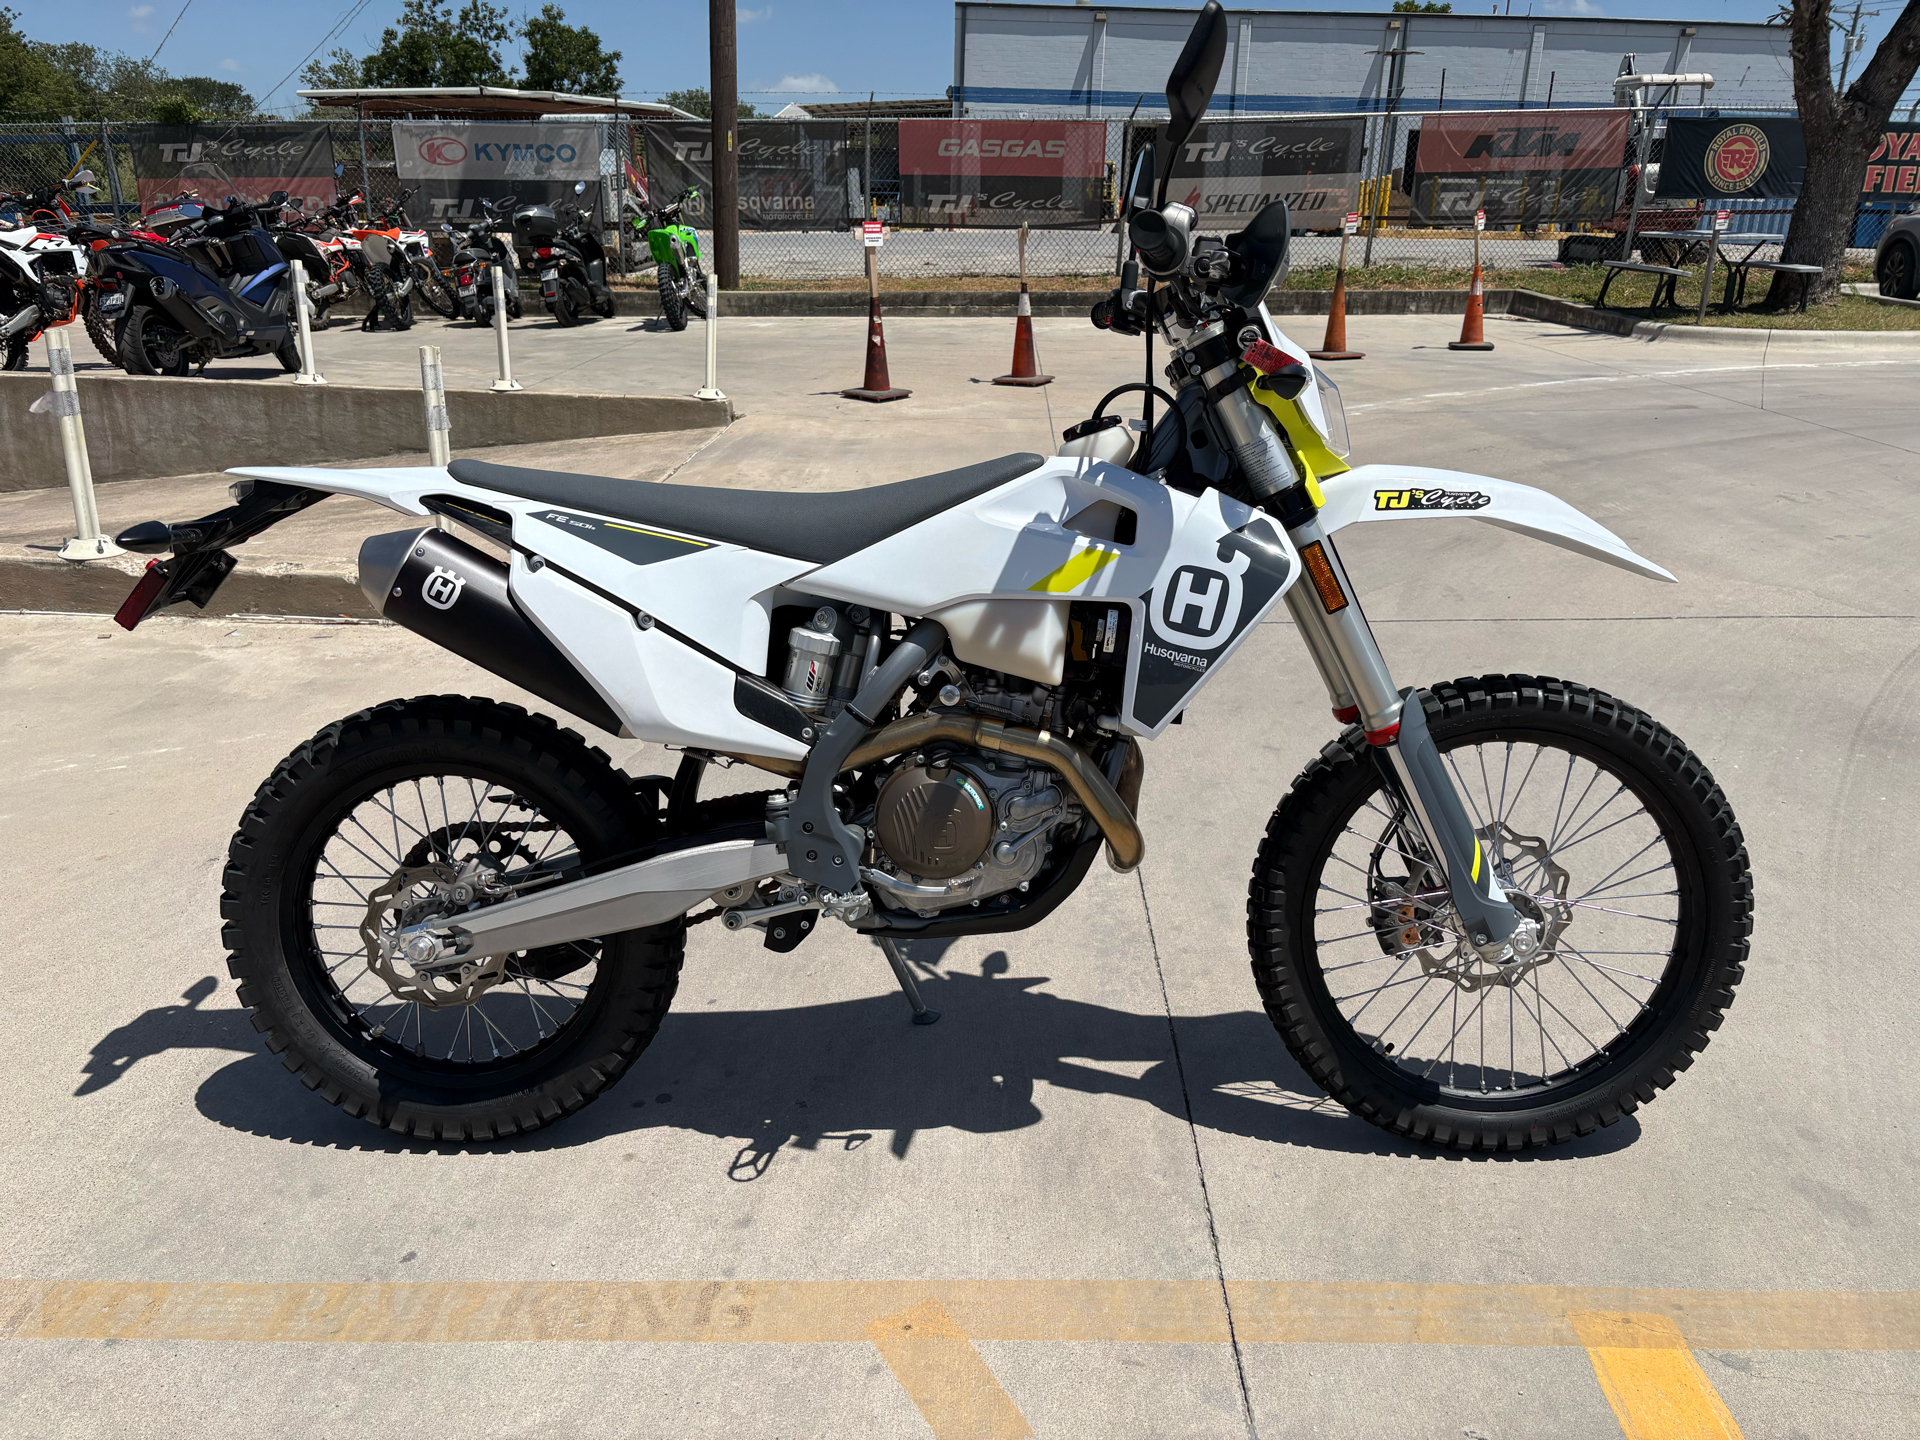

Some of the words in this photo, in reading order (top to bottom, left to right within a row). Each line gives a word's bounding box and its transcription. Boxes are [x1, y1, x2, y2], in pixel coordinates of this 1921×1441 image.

[220, 138, 304, 158] Cycle
[737, 137, 818, 158] Cycle
[938, 138, 1066, 158] GASGAS
[1248, 136, 1335, 158] Cycle
[1463, 126, 1582, 158] KTM
[1711, 128, 1738, 151] ROYAL
[1739, 126, 1767, 151] ENFIELD
[474, 143, 576, 163] KYMCO
[1712, 175, 1734, 190] SINCE
[1735, 174, 1756, 189] 1901
[989, 191, 1075, 210] Cycle
[1501, 186, 1589, 206] Cycle
[763, 213, 815, 221] MOTORCYCLES
[1420, 489, 1489, 508] Cycle
[545, 513, 570, 523] FE
[1144, 641, 1208, 668] Husqvarna
